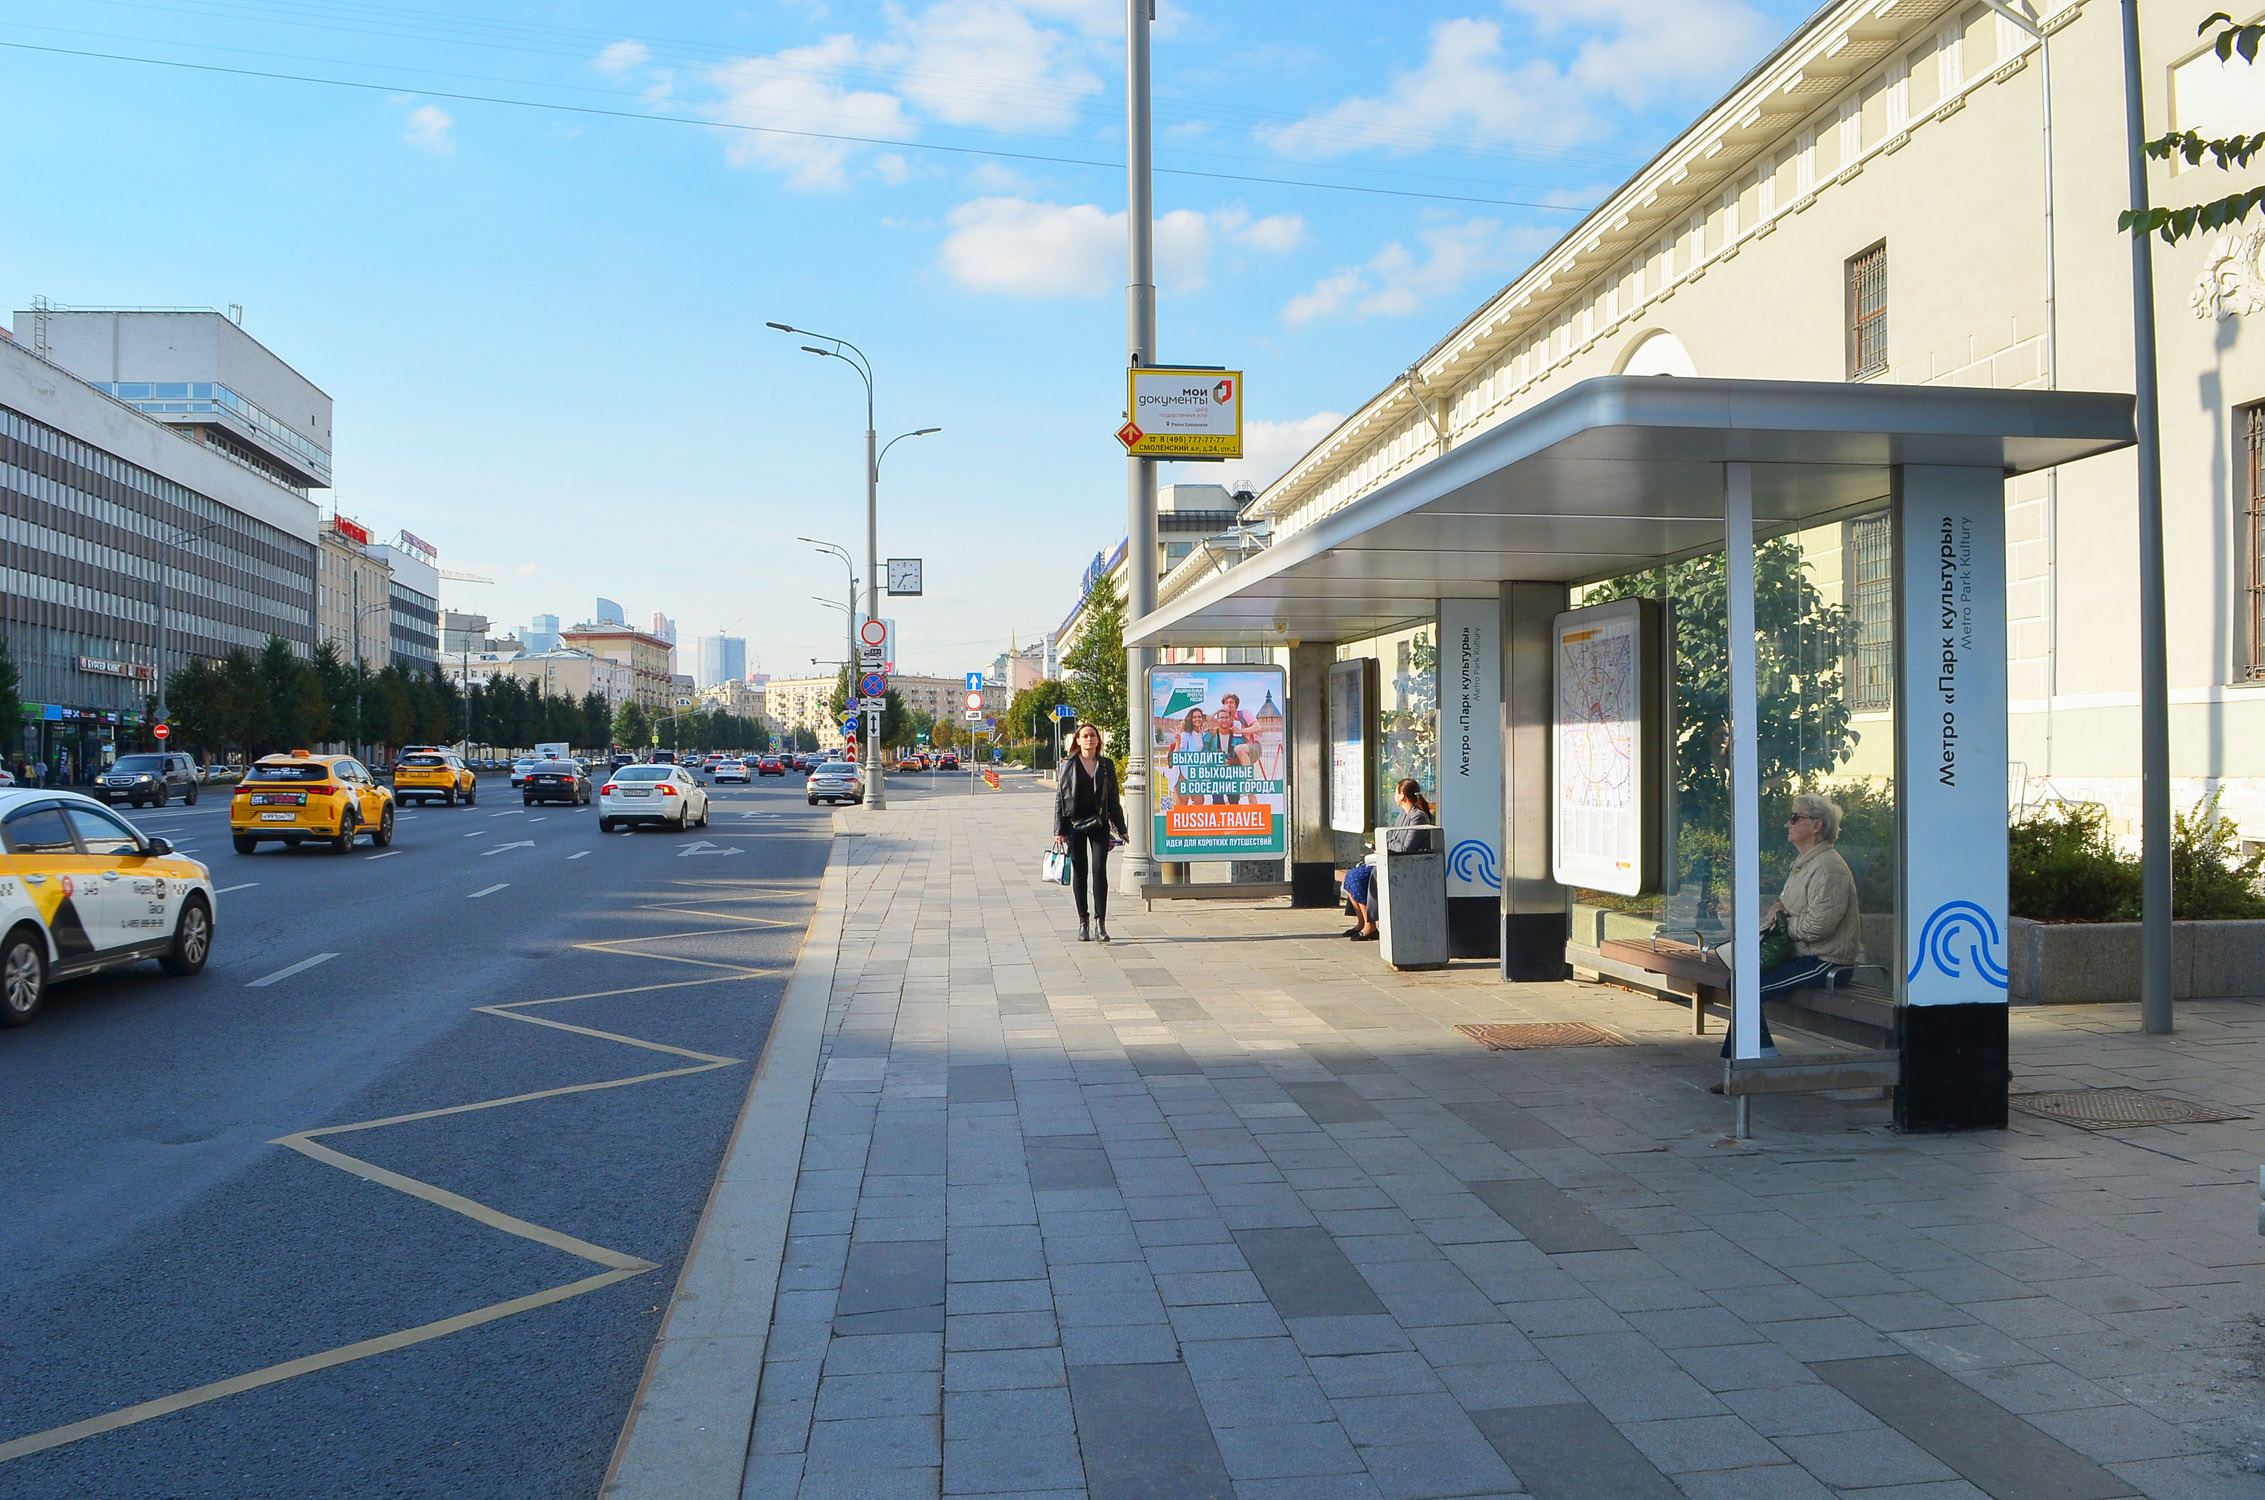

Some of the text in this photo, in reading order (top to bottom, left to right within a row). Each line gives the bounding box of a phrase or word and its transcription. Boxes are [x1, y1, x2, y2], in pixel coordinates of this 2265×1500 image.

[1183, 388, 1208, 397] мои
[1138, 395, 1208, 407] документы
[1159, 435, 1225, 444] 8 (495) 777-77-77
[1138, 443, 1189, 452] СМОЛЕНСКИЙ
[1961, 517, 1973, 650] Metro Park Kultury
[1473, 627, 1481, 655] Kultury
[1939, 516, 1958, 787] Метро «Парк культуры»
[1459, 627, 1471, 777] Метро «Парк культуры»
[1172, 752, 1224, 765] ВЫХОДИТЕ
[1190, 766, 1253, 779] В ВЫХОДНЫЕ
[1180, 780, 1276, 795] В СОСЕДНИЕ ГОРОДА
[1173, 811, 1266, 829] RUSSIA.TRAVEL
[1166, 836, 1272, 848] ИДЕИ ДЛЯ КОРОТКИХ ПУТЕШЕСТВИЙ
